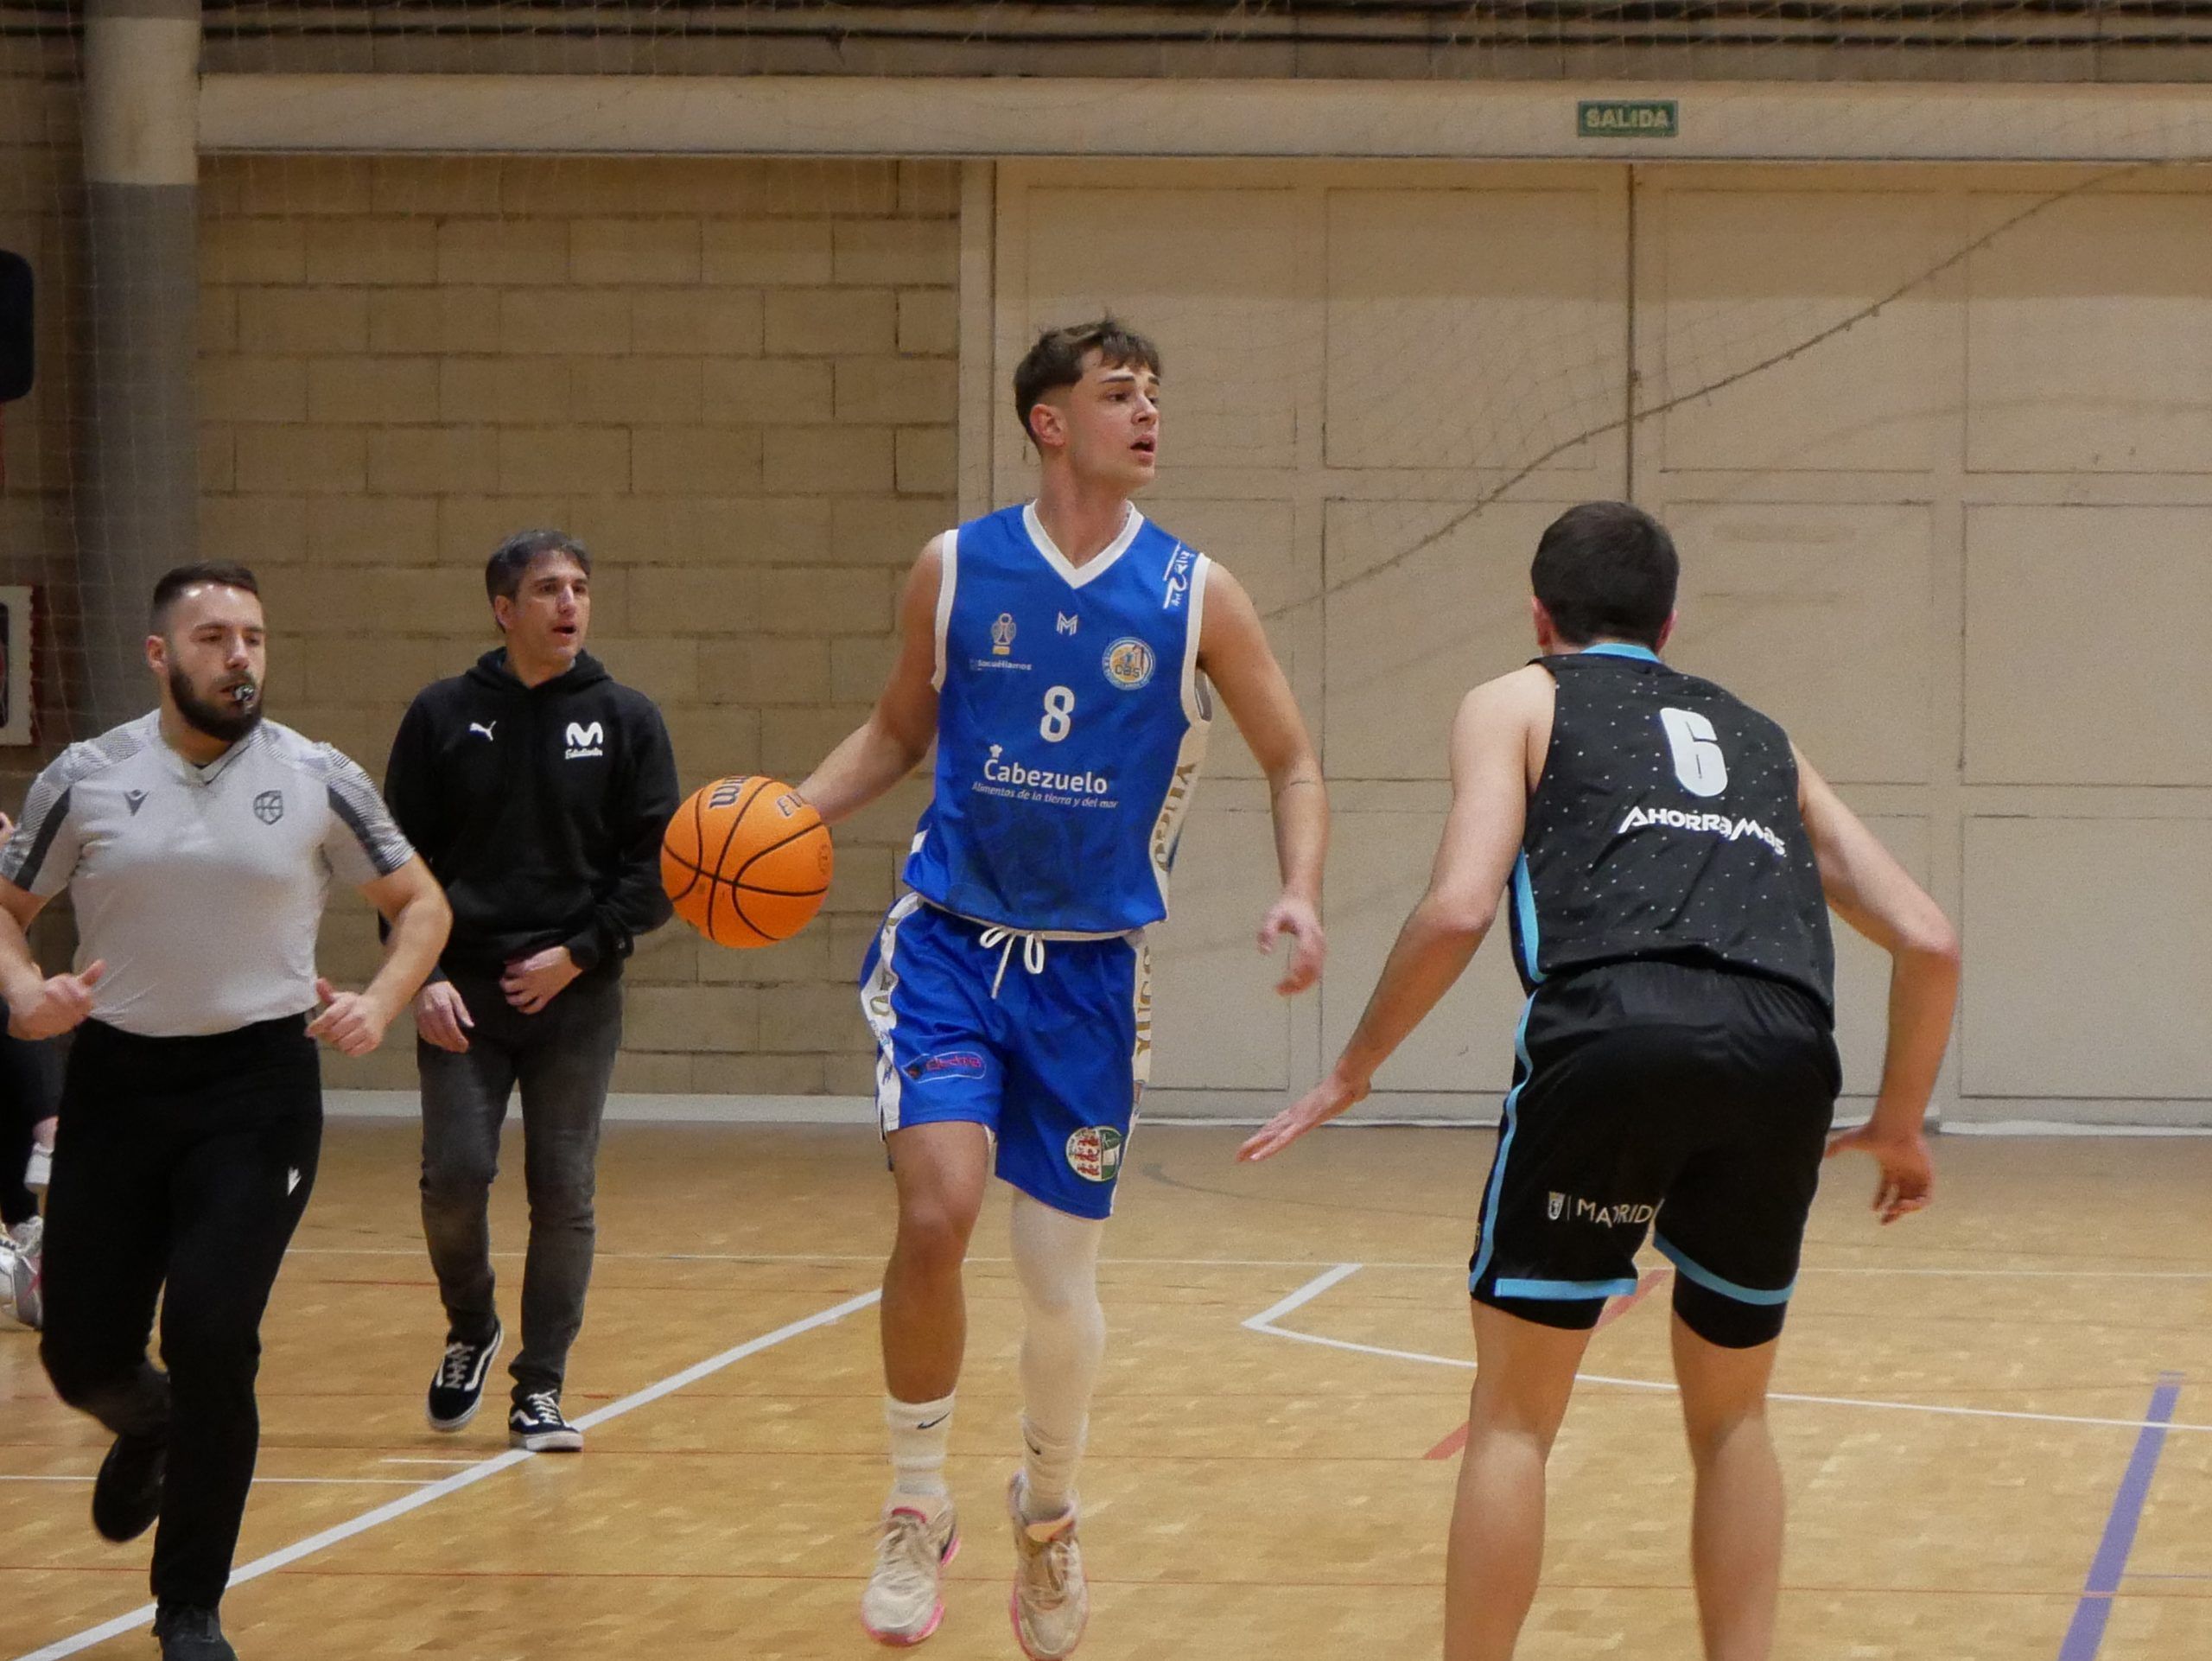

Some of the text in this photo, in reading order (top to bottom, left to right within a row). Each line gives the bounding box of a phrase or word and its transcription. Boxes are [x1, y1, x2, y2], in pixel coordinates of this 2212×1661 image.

[1586, 107, 1669, 128] SALIDA
[1039, 685, 1075, 743] 8
[1659, 707, 1729, 798] 6
[983, 759, 1108, 794] Cabezuelo
[971, 781, 1119, 809] Alimentos de la tierra y del mar
